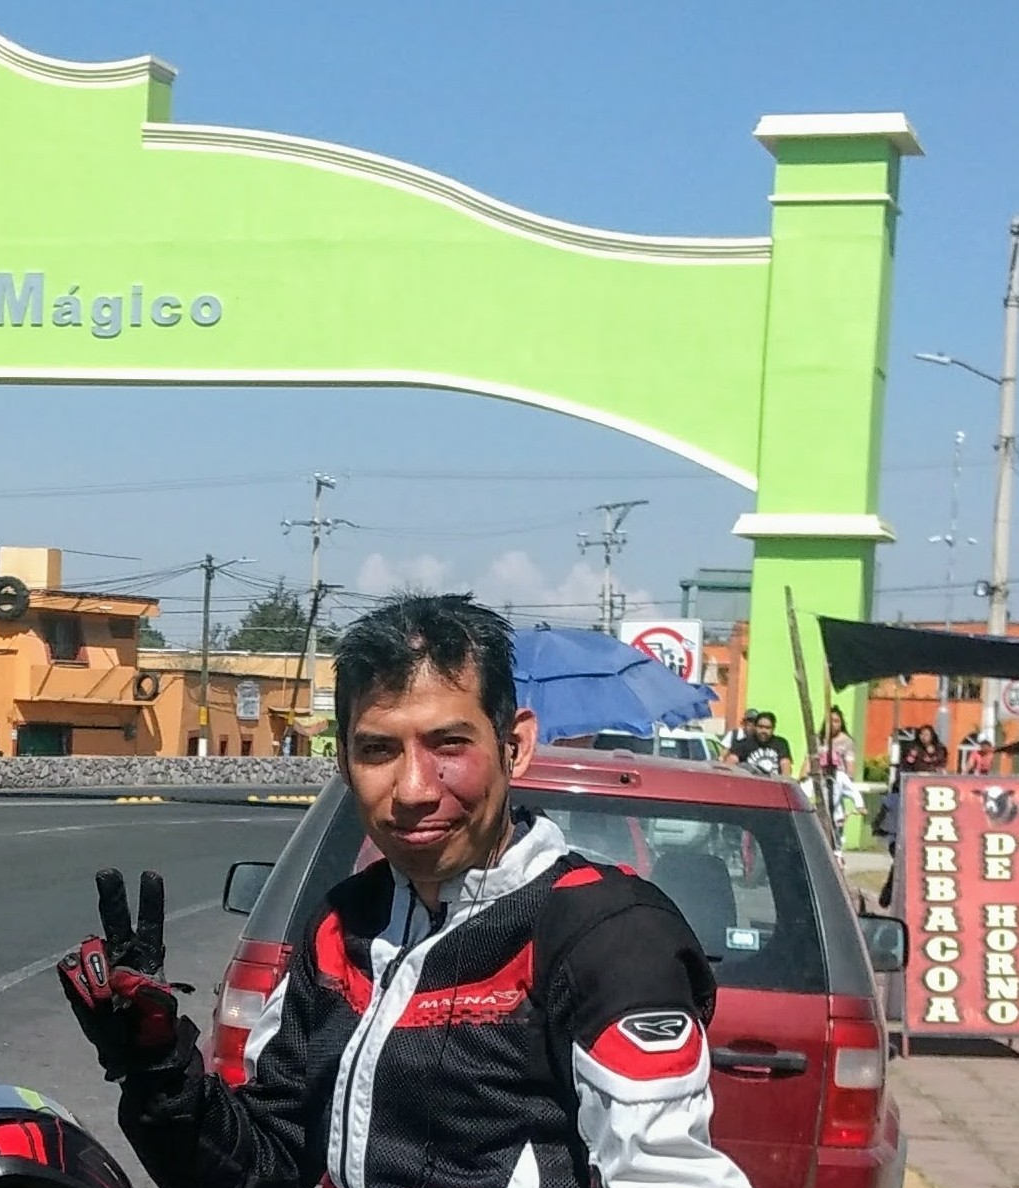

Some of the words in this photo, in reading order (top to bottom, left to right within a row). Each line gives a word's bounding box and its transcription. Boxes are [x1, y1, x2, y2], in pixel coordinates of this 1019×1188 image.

[923, 785, 960, 1024] BARBACOA
[984, 833, 1017, 881] DE
[985, 904, 1019, 1025] HORNO
